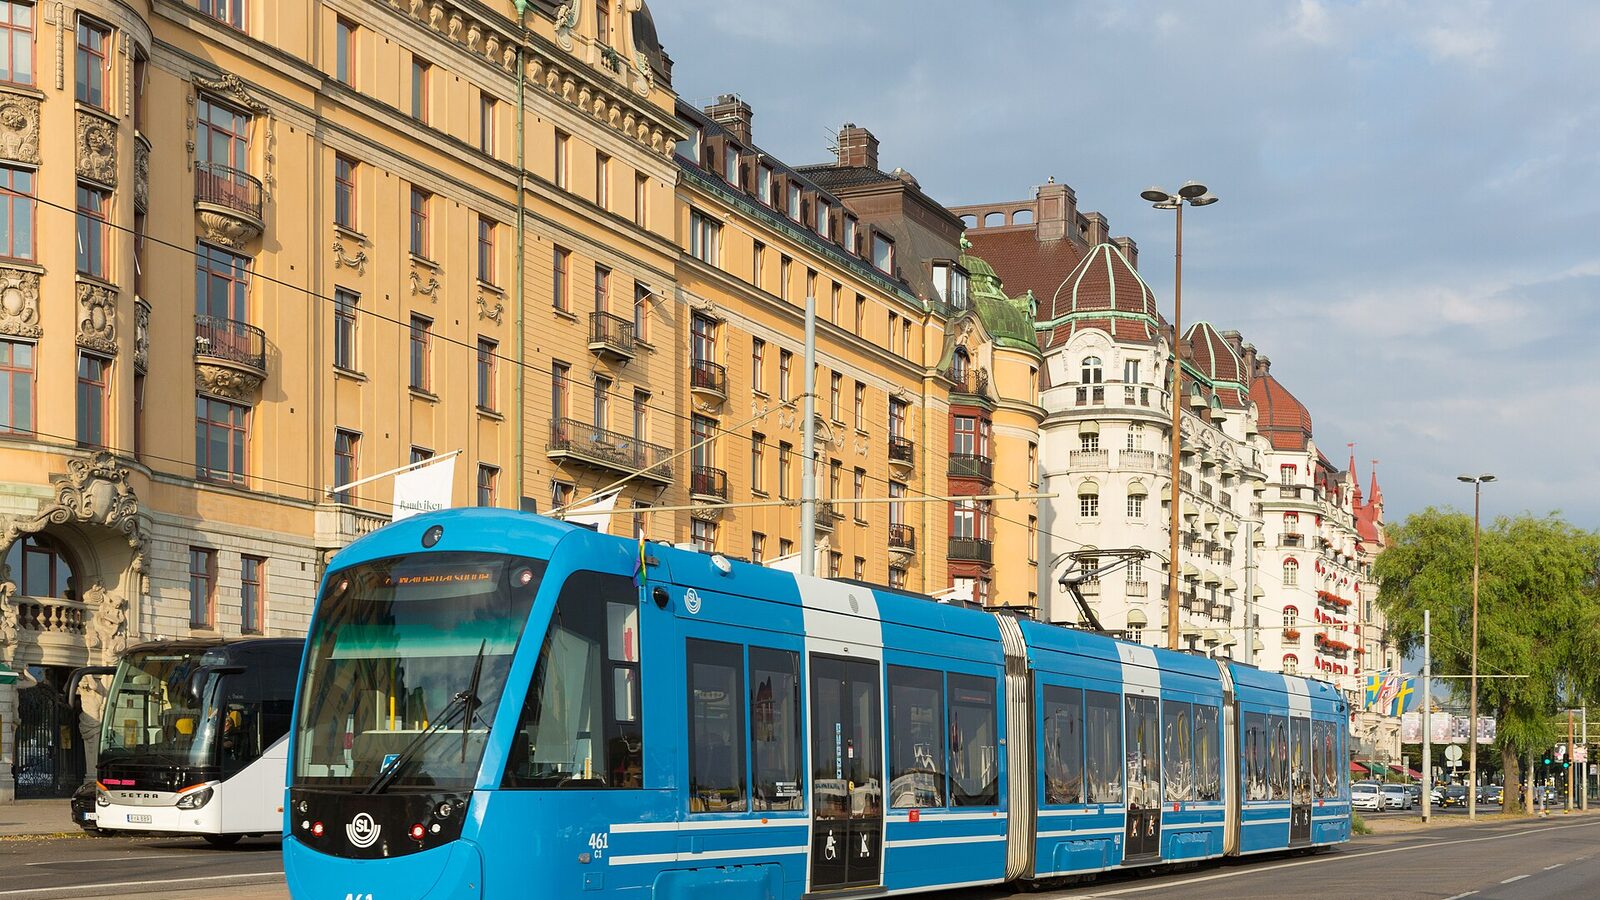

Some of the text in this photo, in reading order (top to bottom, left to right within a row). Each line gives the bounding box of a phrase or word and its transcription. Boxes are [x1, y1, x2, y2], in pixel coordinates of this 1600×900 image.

[688, 592, 697, 602] SL
[355, 819, 371, 833] SL
[589, 833, 608, 849] 461
[594, 850, 602, 858] C1
